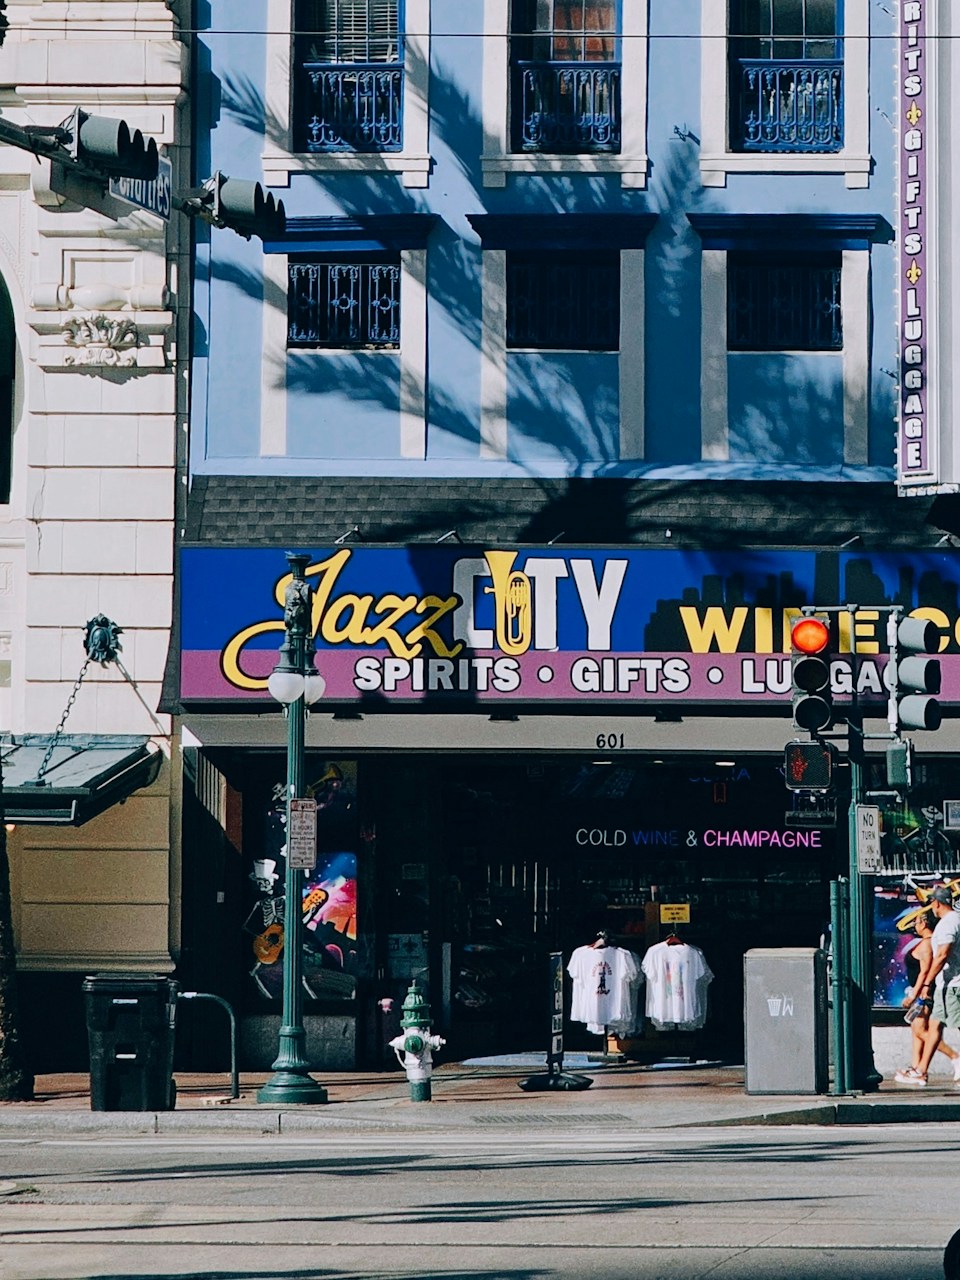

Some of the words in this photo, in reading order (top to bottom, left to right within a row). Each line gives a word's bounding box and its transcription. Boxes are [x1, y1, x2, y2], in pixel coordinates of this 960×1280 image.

[903, 128, 923, 255] GIFTS
[903, 287, 924, 469] LUGGAGE
[221, 548, 464, 691] Jazz
[679, 606, 879, 654] WIE
[354, 657, 521, 693] SPIRITS
[570, 657, 691, 693] GIFTS
[741, 658, 891, 694] LUGA
[596, 733, 624, 748] 601
[863, 813, 874, 827] NO
[575, 828, 627, 846] COLD
[632, 830, 680, 846] WINE
[686, 829, 698, 847] &
[703, 829, 822, 848] CHAMPAGNE
[862, 830, 876, 840] TURN
